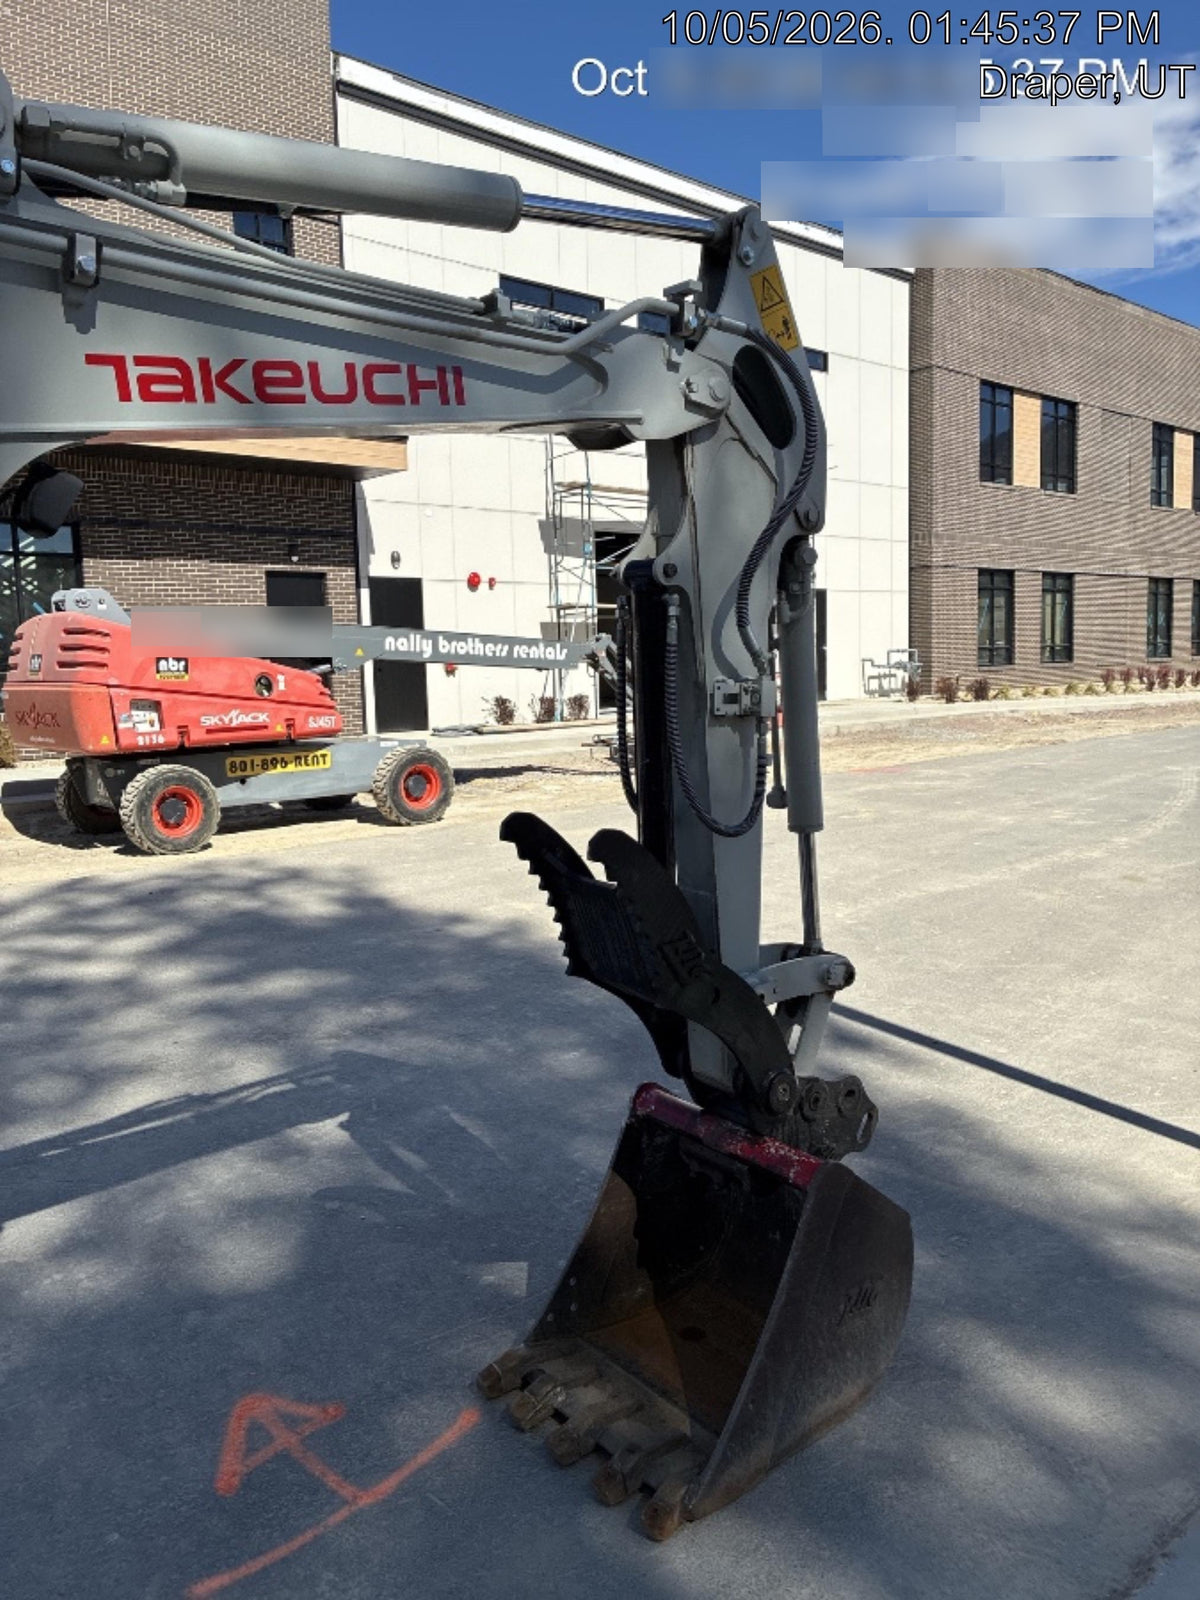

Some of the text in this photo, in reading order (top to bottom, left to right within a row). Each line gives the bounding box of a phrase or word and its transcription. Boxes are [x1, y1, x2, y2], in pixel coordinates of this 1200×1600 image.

[384, 634, 569, 661] nally brothers rentals
[158, 657, 186, 671] nbr
[200, 709, 270, 727] SKYJACK
[228, 753, 328, 774] 801-896-RENT
